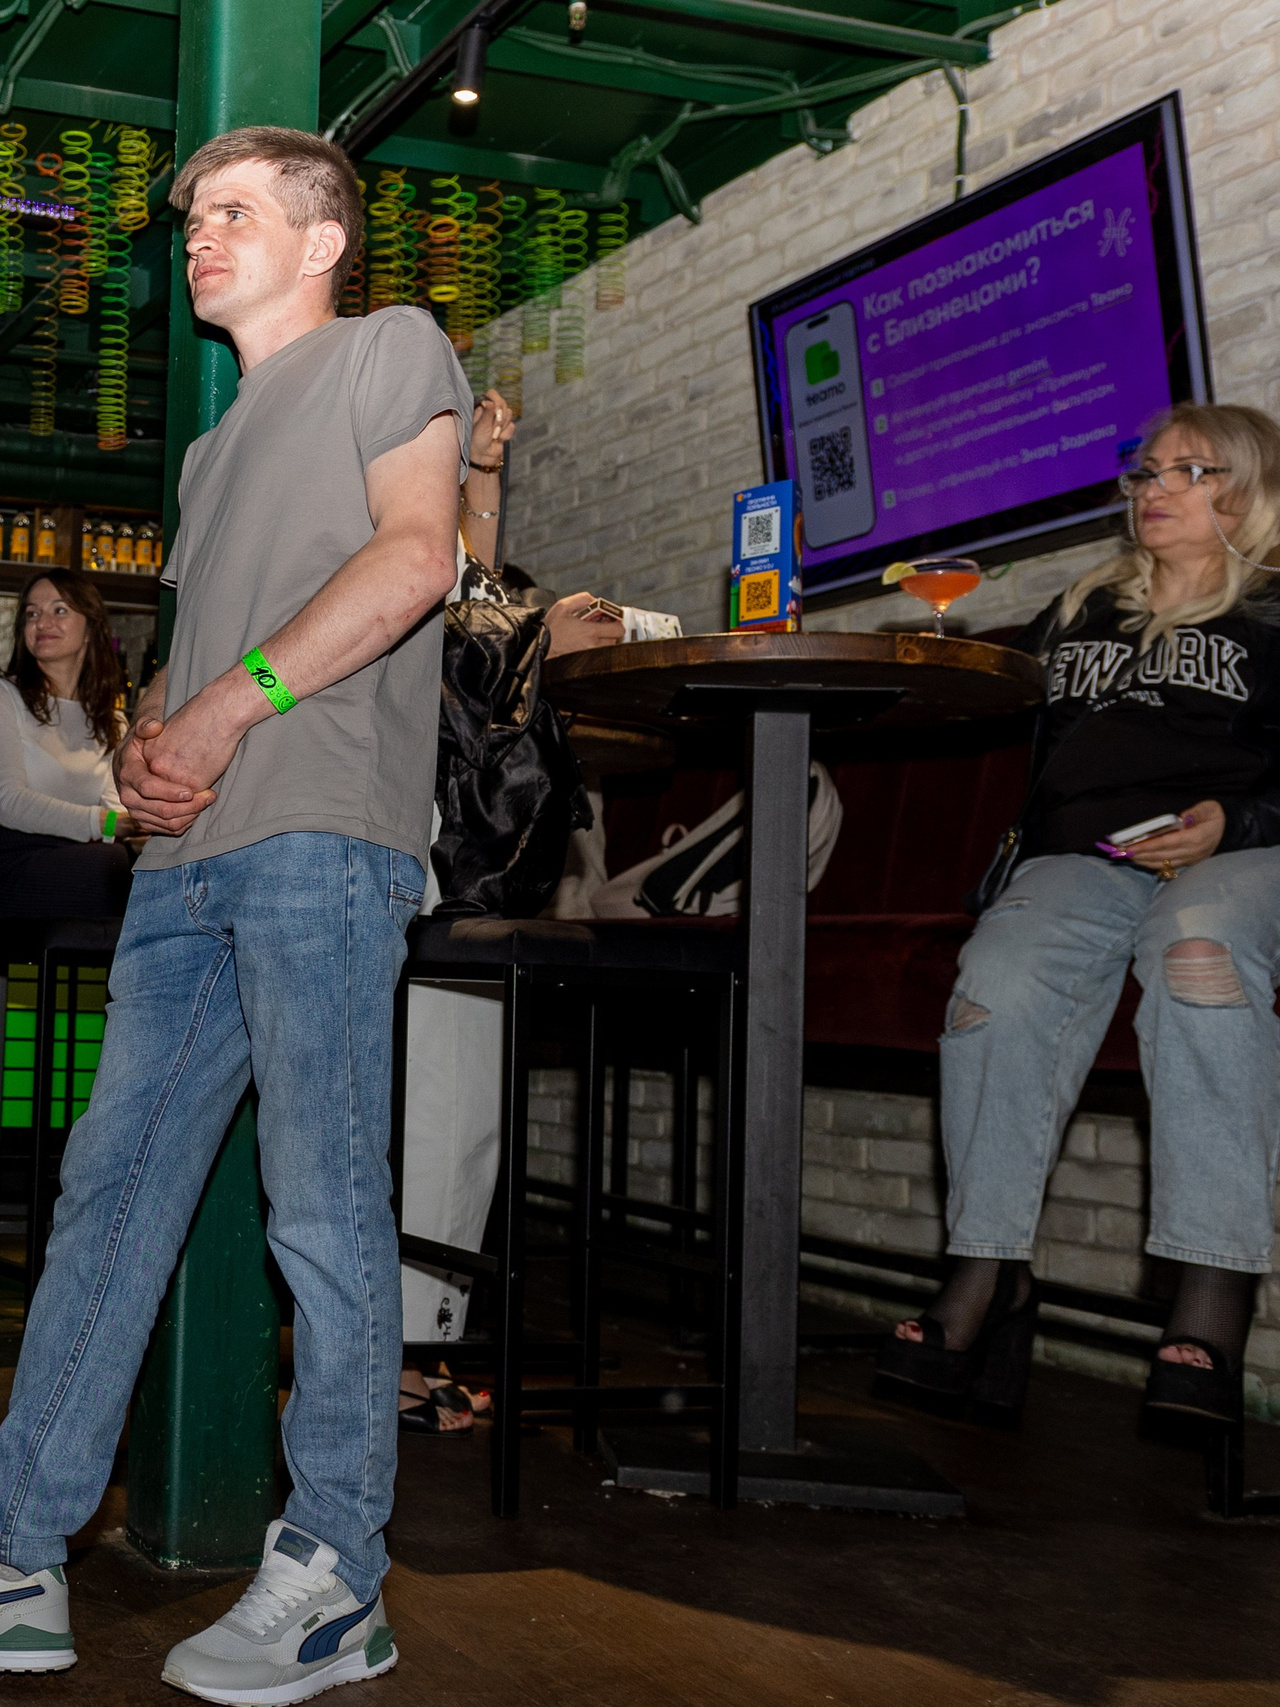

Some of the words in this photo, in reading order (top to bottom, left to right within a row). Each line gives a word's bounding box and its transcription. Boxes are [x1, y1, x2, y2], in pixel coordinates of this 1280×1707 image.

[863, 287, 903, 319] Как
[908, 200, 1094, 299] познакомиться
[867, 333, 880, 353] с
[885, 256, 1040, 346] Близнецами?
[1048, 640, 1133, 704] EW
[1117, 628, 1248, 702] ORK
[278, 1539, 302, 1557] PUMA
